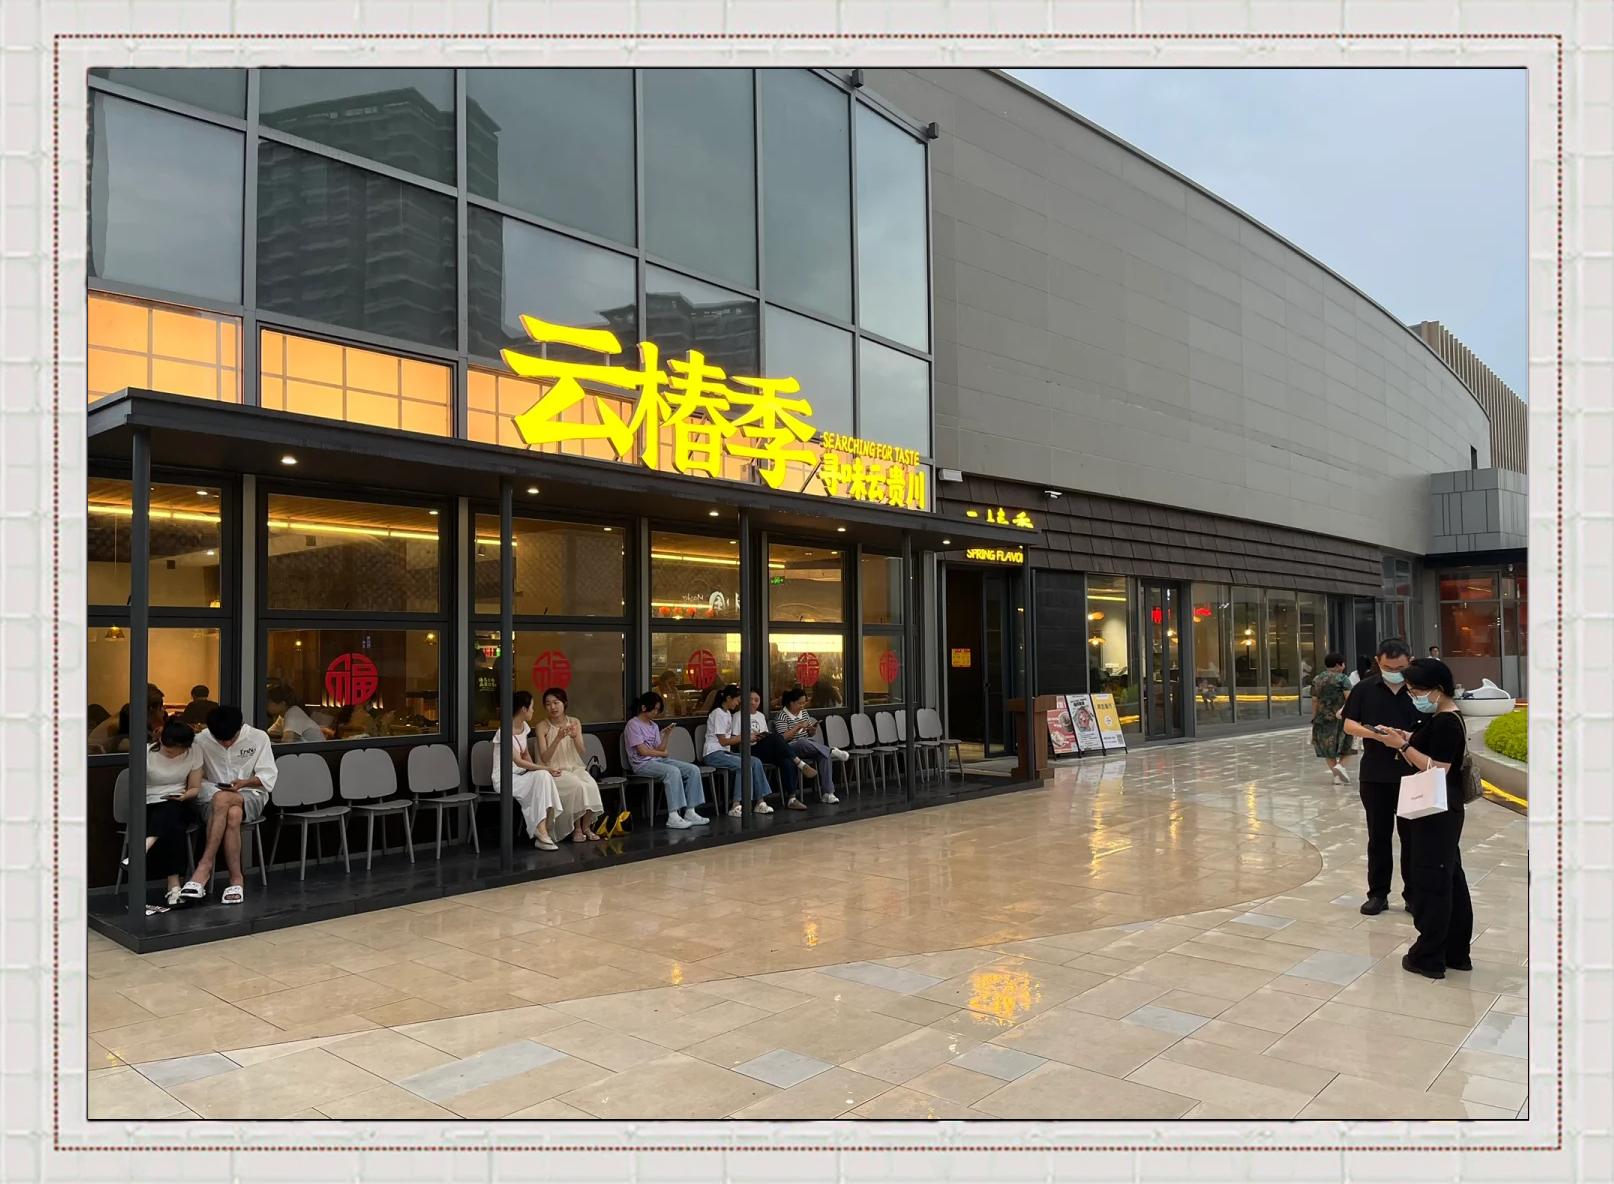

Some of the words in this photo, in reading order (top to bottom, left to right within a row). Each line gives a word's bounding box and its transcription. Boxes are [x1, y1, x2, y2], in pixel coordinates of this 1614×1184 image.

[500, 313, 817, 489] 云椿季
[822, 431, 876, 457] SEARCHING
[876, 443, 894, 460] FOR
[895, 447, 920, 466] TASTE
[818, 452, 925, 510] 寻味云贵川
[966, 548, 996, 561] SPRING
[325, 652, 379, 706] 福
